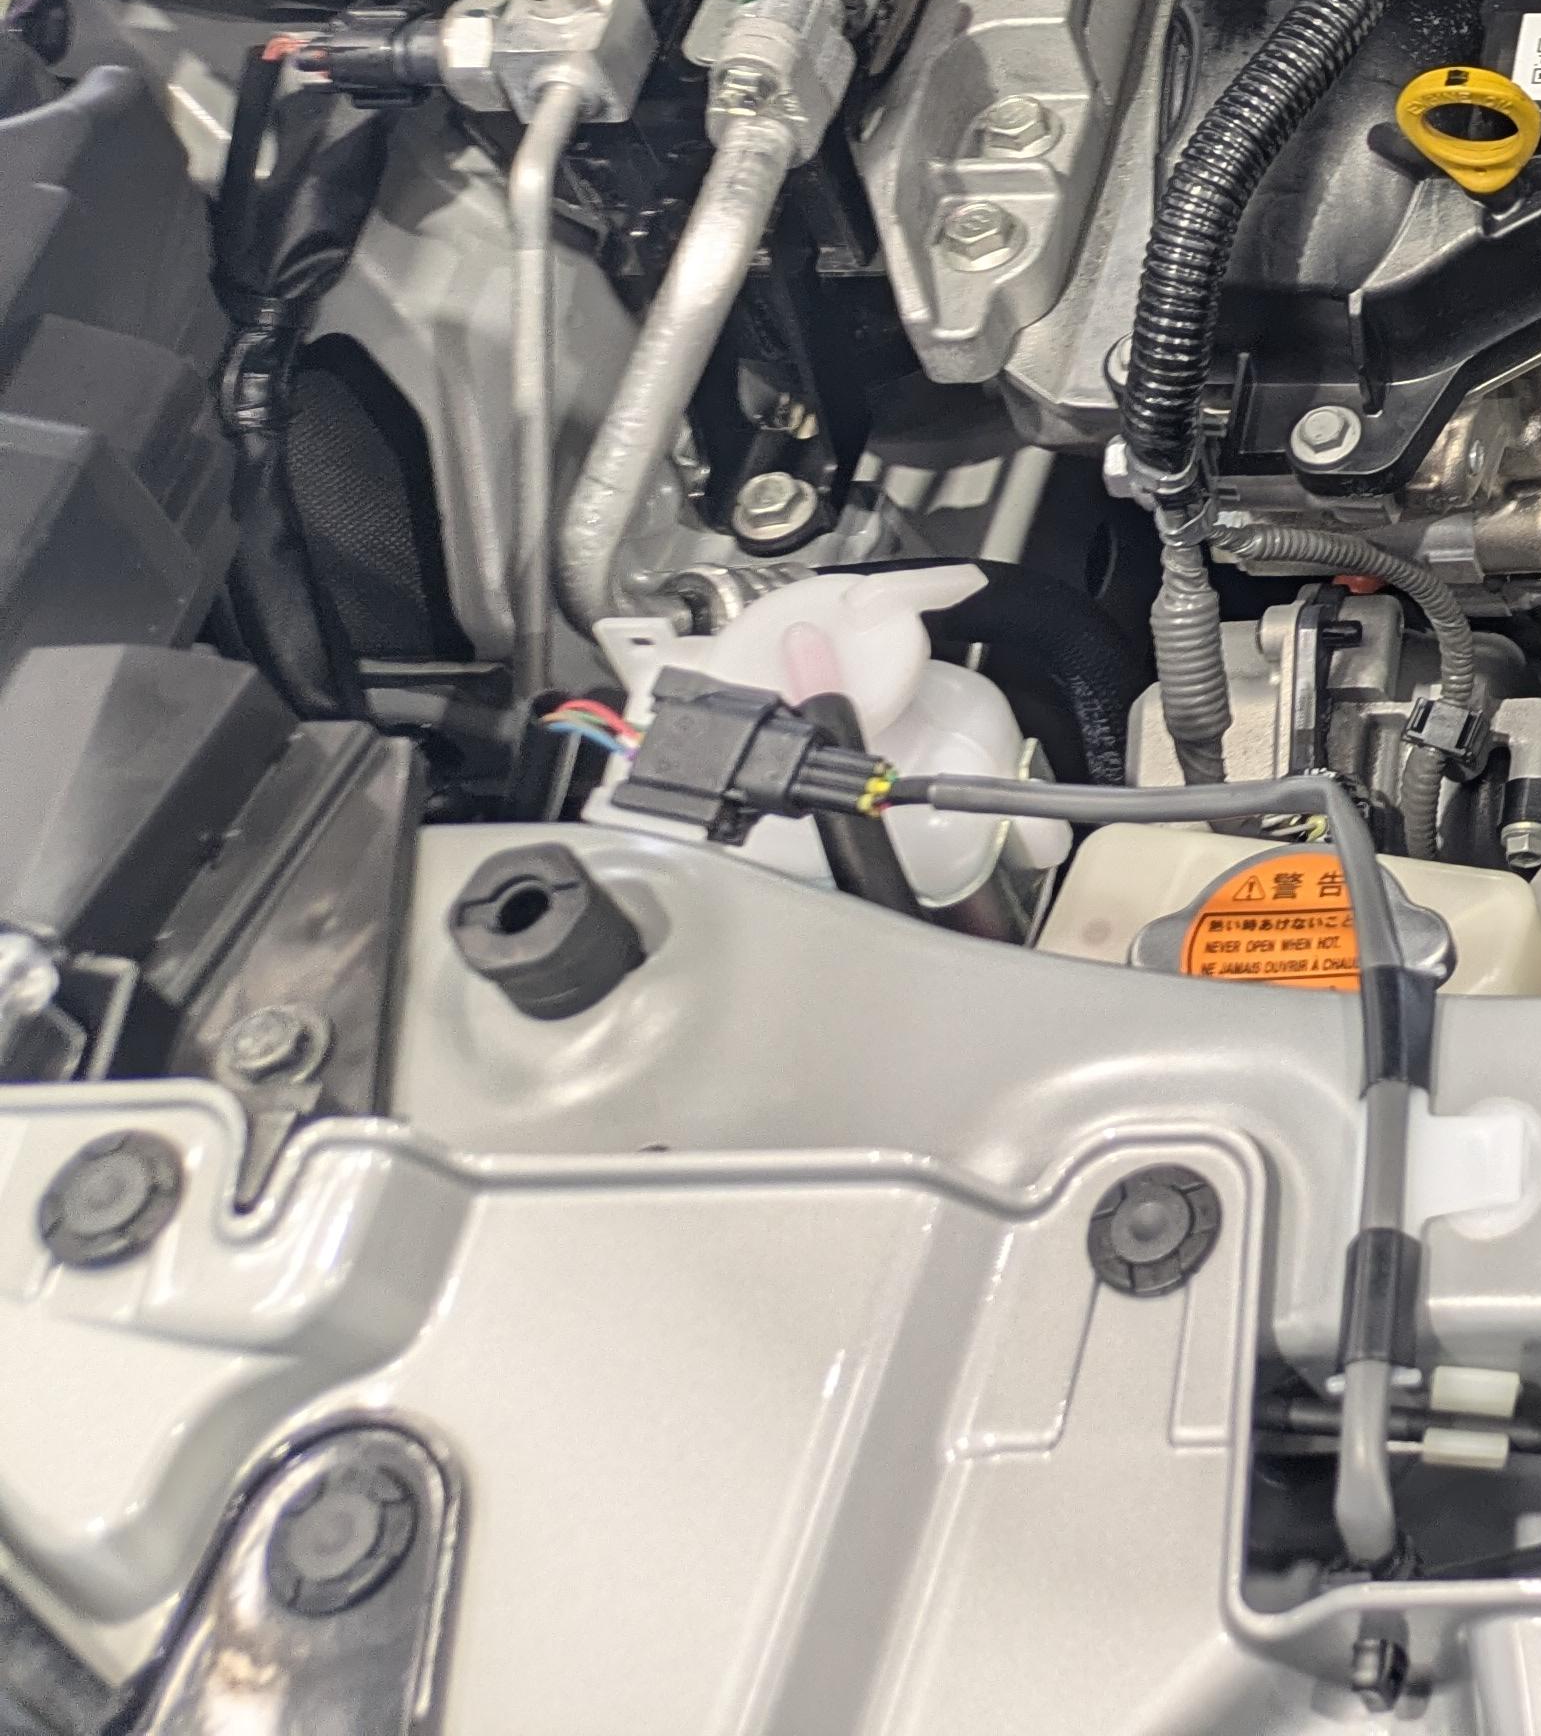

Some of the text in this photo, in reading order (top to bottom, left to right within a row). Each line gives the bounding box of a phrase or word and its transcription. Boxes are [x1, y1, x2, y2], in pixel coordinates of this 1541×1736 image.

[1272, 872, 1345, 901] 警告
[1204, 935, 1342, 954] NEVER OPEN WHEN HOT.
[1219, 961, 1261, 974] JAMAIS
[1264, 959, 1308, 973] OUVRIR
